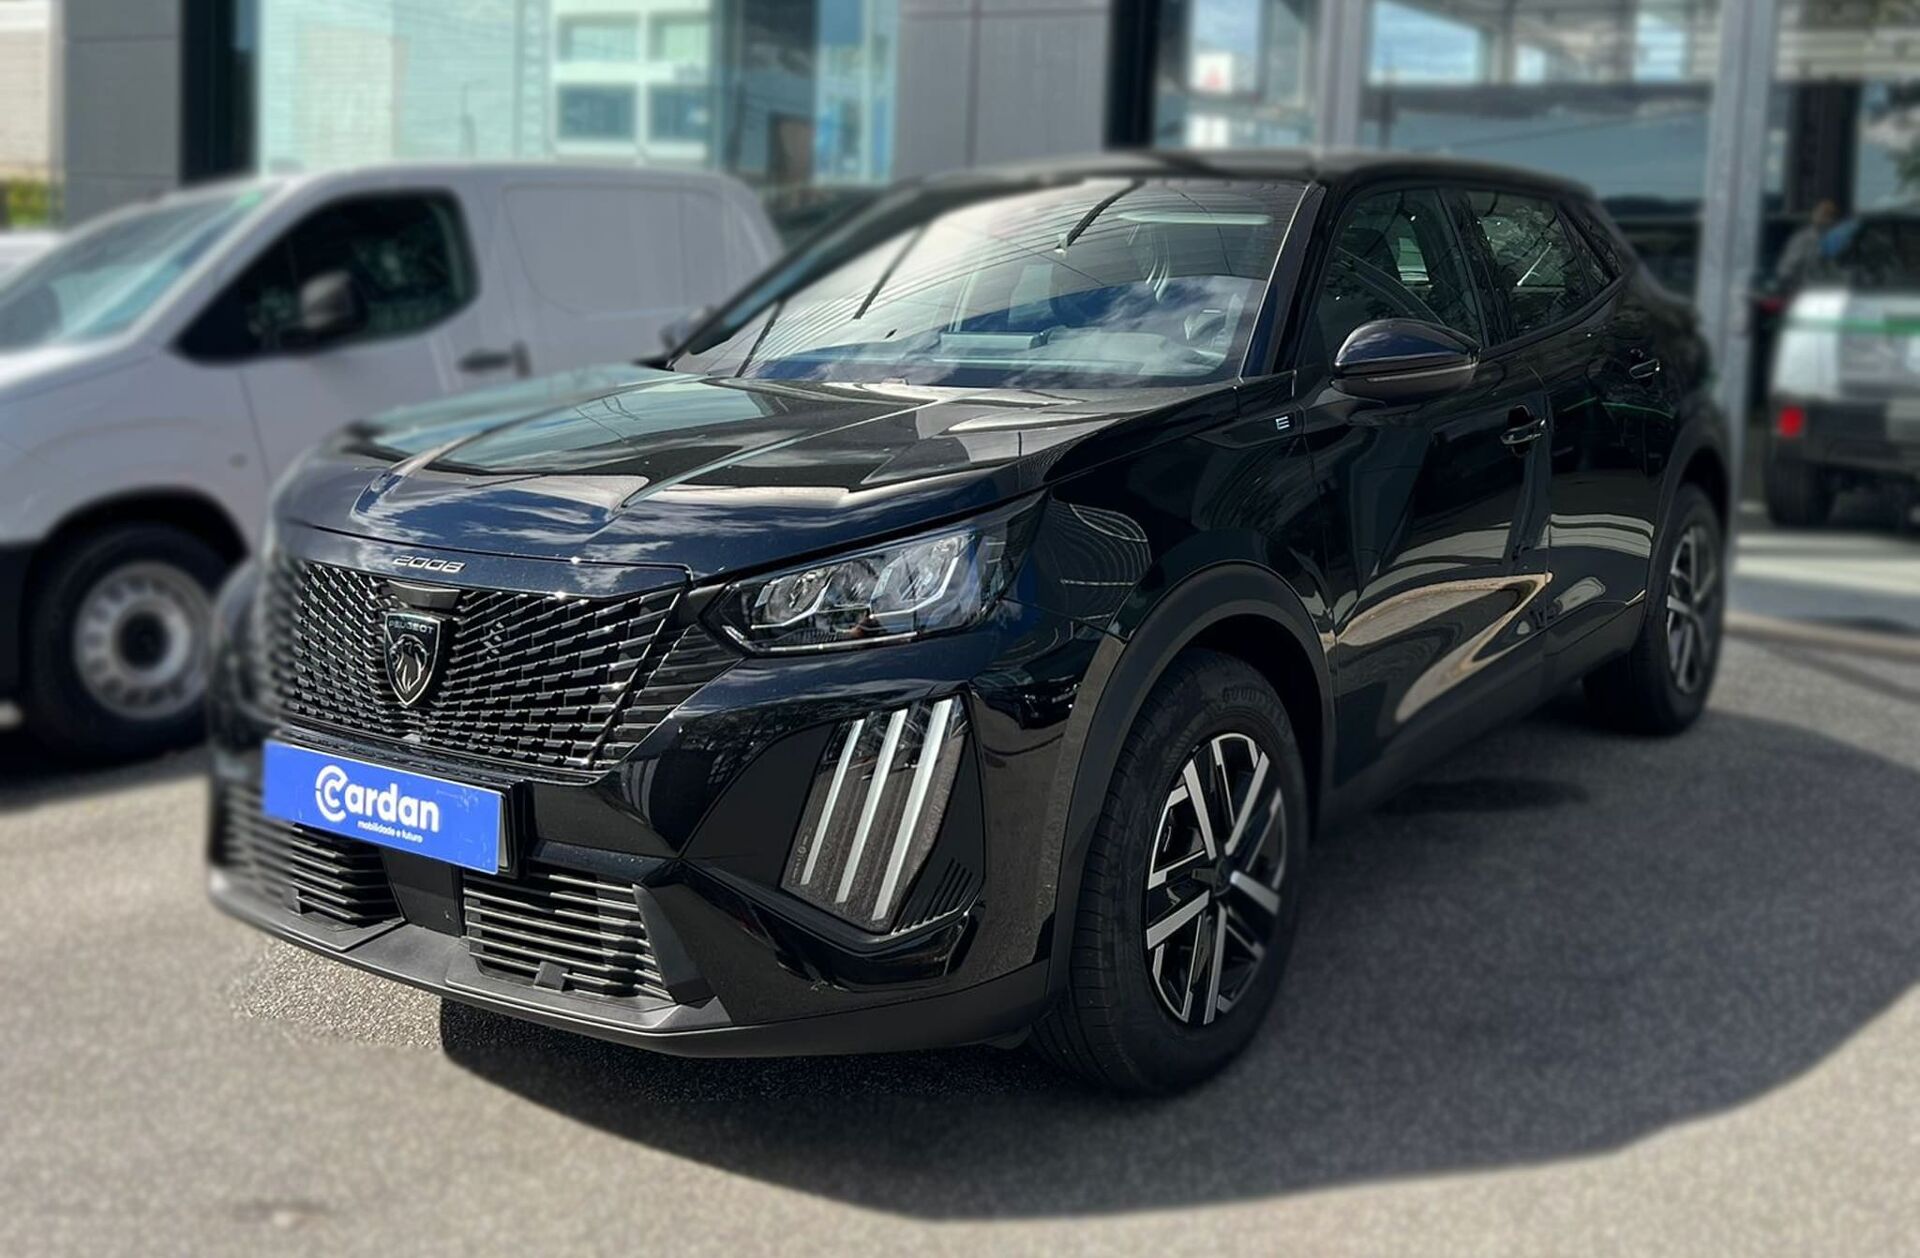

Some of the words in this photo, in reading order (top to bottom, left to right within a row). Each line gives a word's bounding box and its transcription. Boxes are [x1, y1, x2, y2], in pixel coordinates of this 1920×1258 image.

[392, 555, 466, 573] 2008
[388, 620, 434, 634] PEUGEOT
[315, 765, 440, 833] Cardan
[357, 820, 396, 837] mobilidade
[402, 829, 424, 843] futuro
